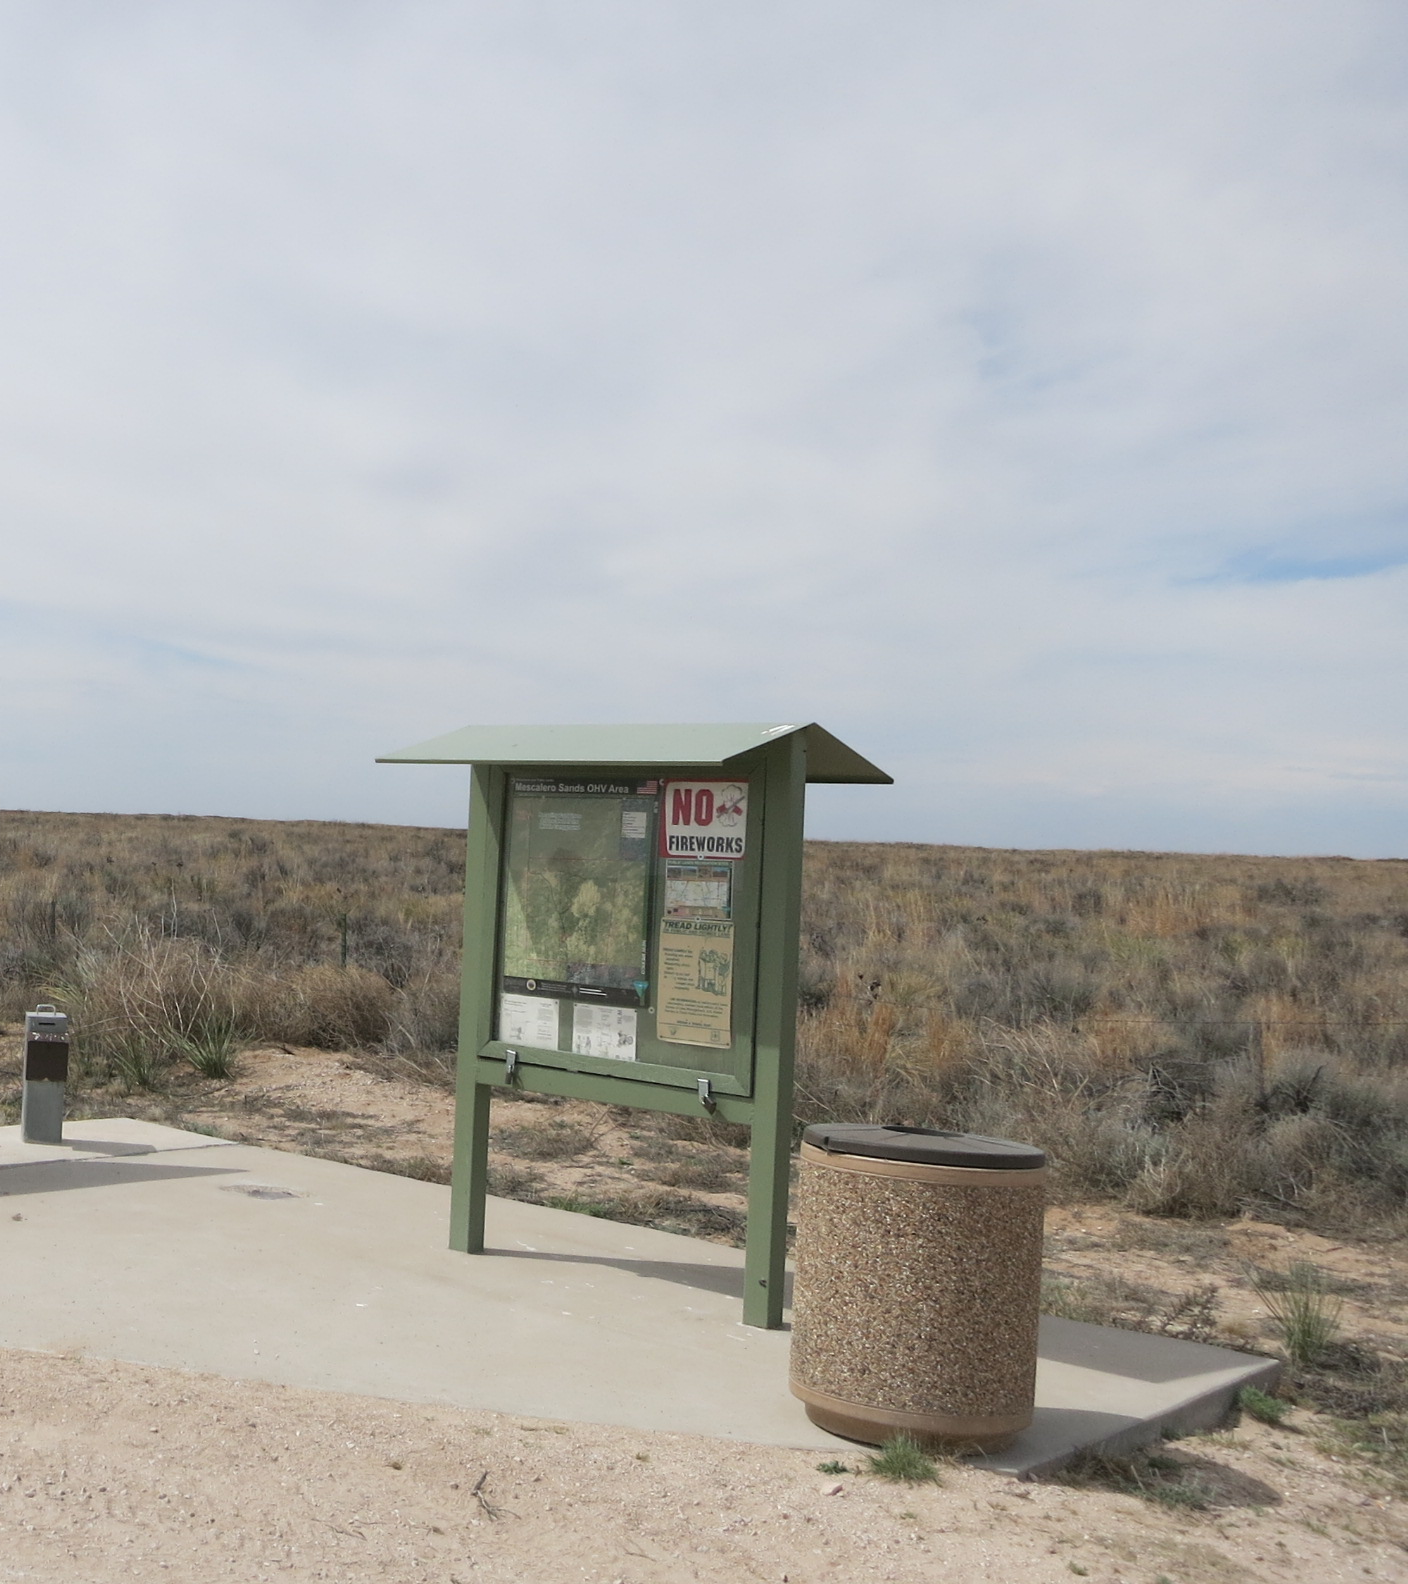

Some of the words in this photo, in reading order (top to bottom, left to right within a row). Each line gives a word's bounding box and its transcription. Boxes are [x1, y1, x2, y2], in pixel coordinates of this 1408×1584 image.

[515, 782, 556, 793] Mescalero
[558, 783, 585, 794] Sands
[587, 784, 607, 794] OHV
[609, 784, 629, 795] Area
[672, 788, 714, 826] NO
[669, 835, 743, 853] FIREWORKS
[664, 920, 692, 930] TREAD
